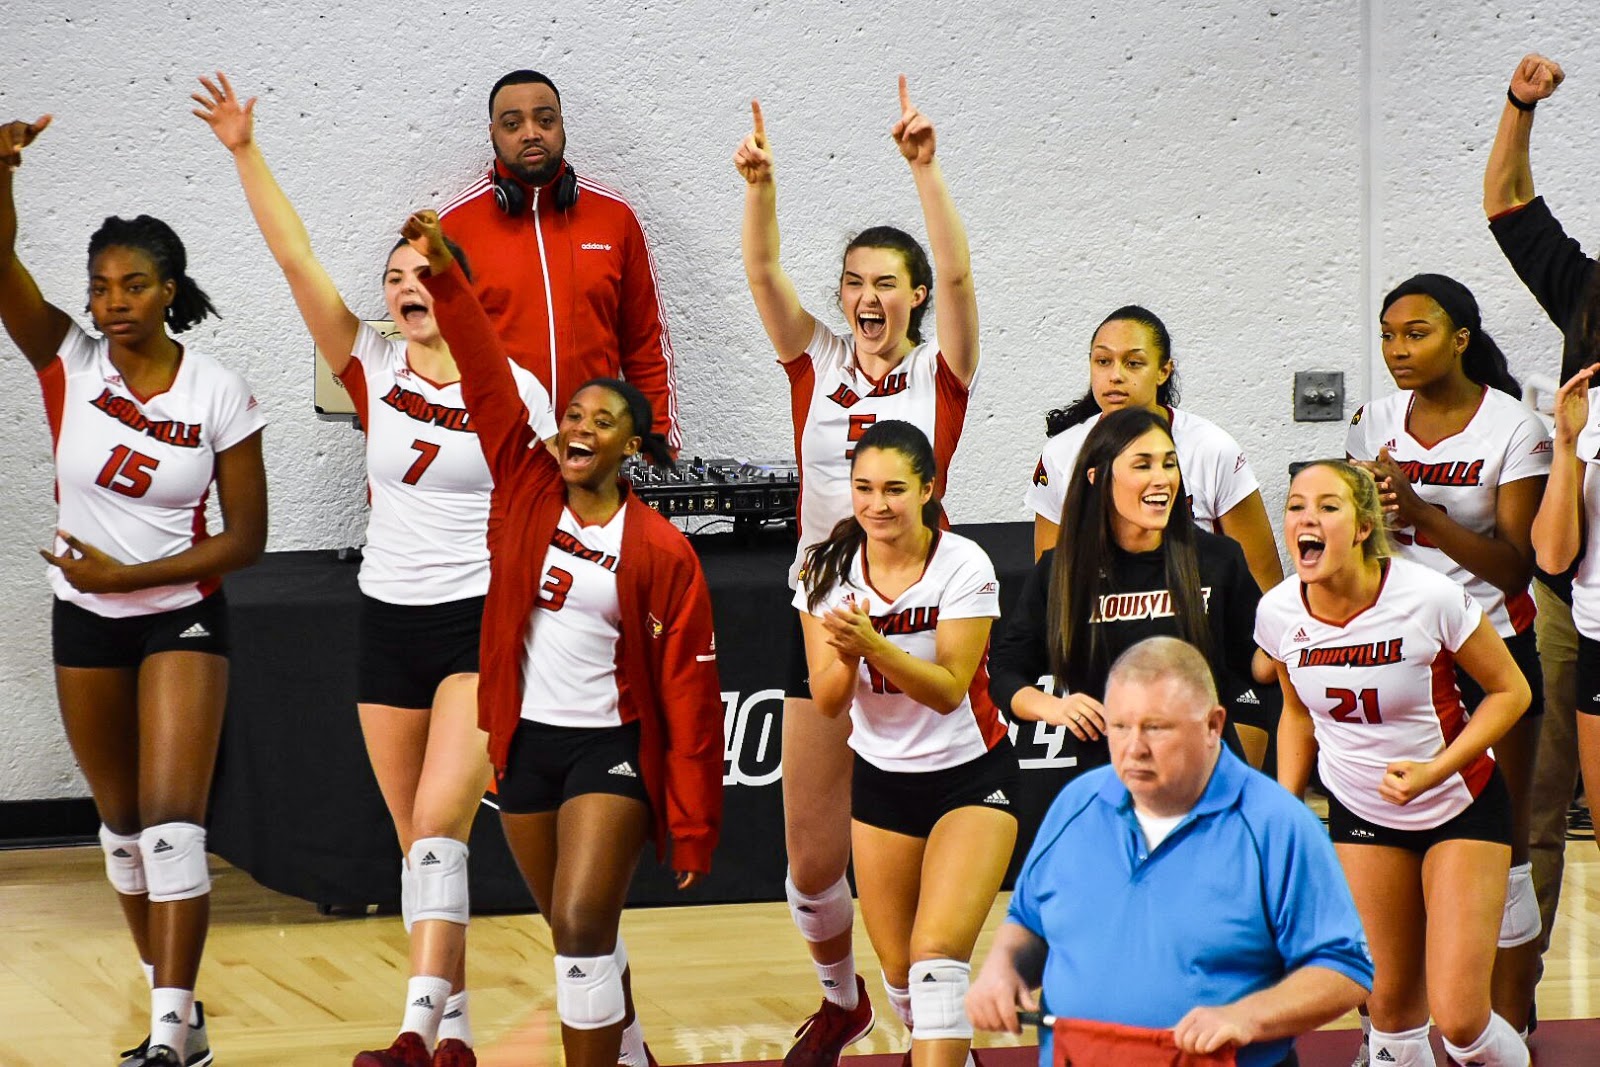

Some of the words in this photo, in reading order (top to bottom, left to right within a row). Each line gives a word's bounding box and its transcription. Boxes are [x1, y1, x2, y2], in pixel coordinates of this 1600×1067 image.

[581, 242, 604, 251] adidas
[95, 444, 160, 499] 15
[401, 439, 441, 486] 7
[535, 565, 574, 612] 3
[1298, 637, 1403, 669] LOUISVILLE
[1236, 697, 1260, 705] adidas
[1325, 687, 1383, 725] 21
[608, 768, 637, 778] adidas
